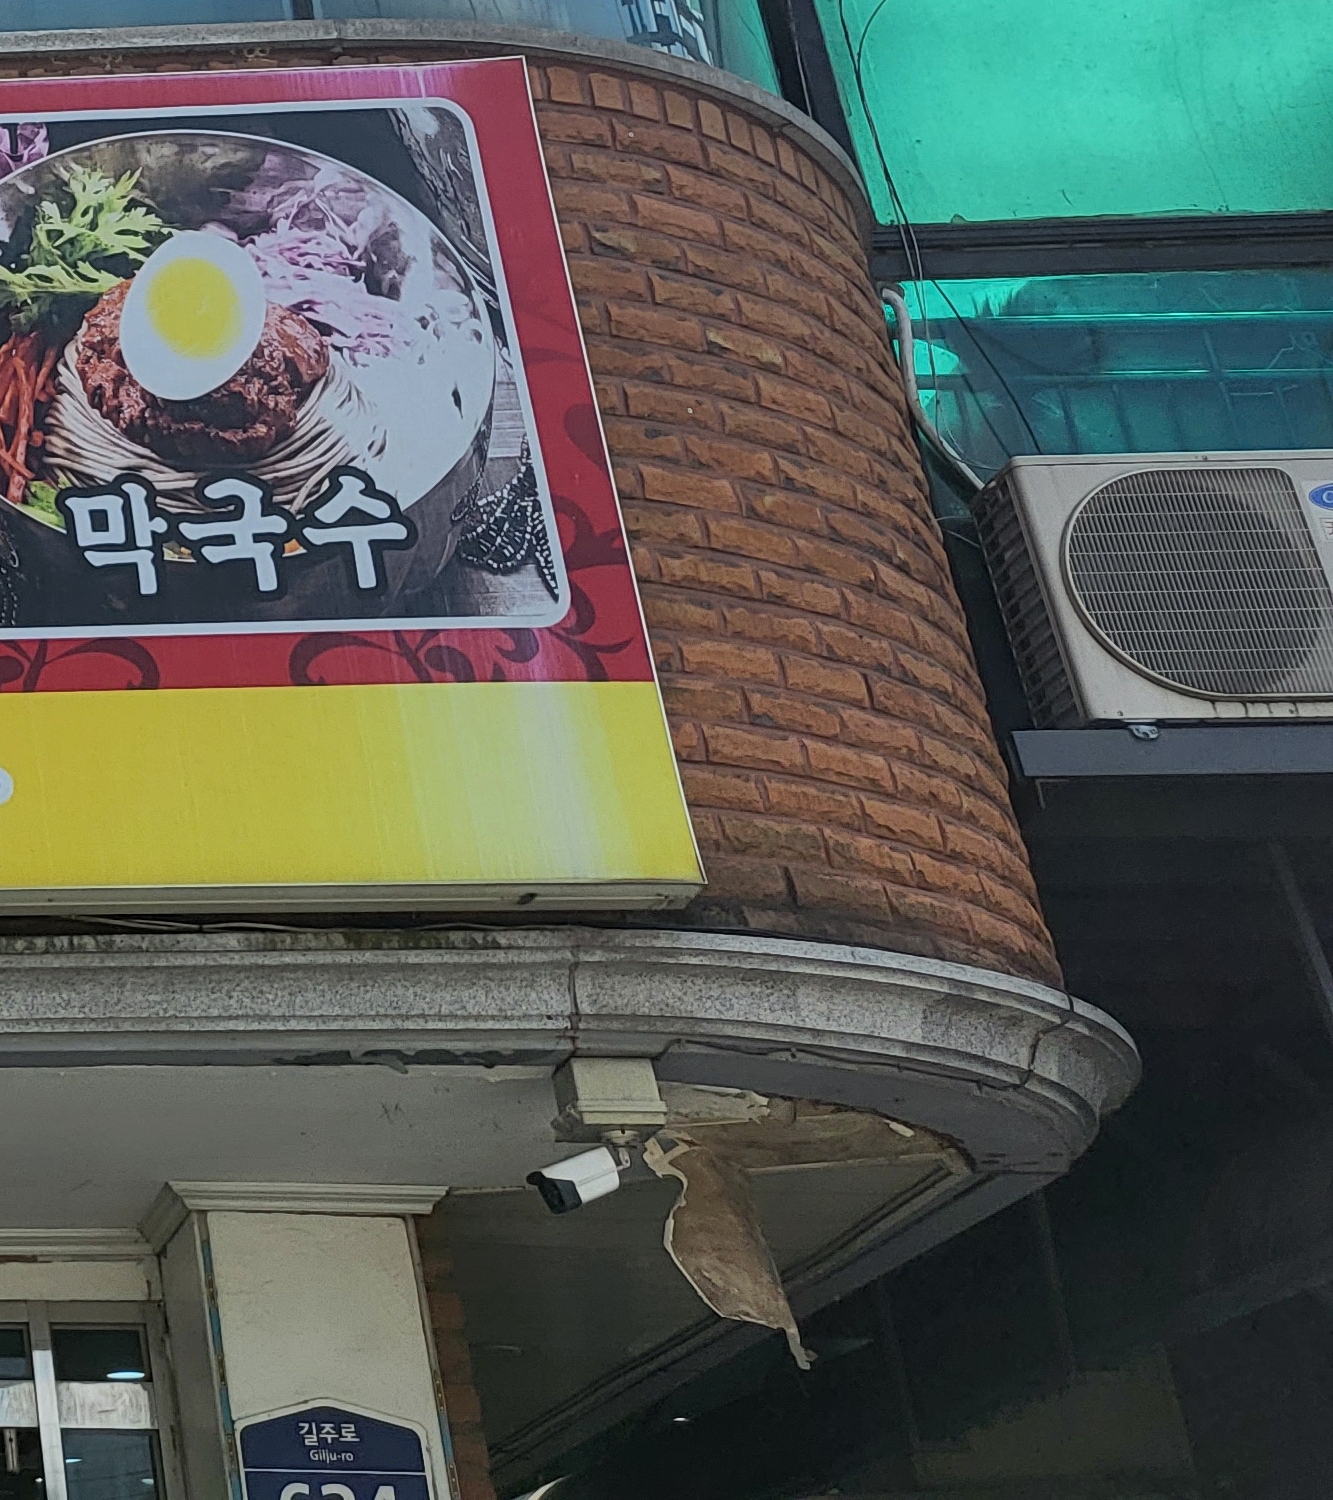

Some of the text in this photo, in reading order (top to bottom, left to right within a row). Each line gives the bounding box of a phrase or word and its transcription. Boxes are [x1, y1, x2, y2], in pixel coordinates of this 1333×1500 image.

[69, 475, 411, 596] 막국수
[298, 1422, 360, 1446] 길주로
[309, 1449, 354, 1463] Gilju-ro
